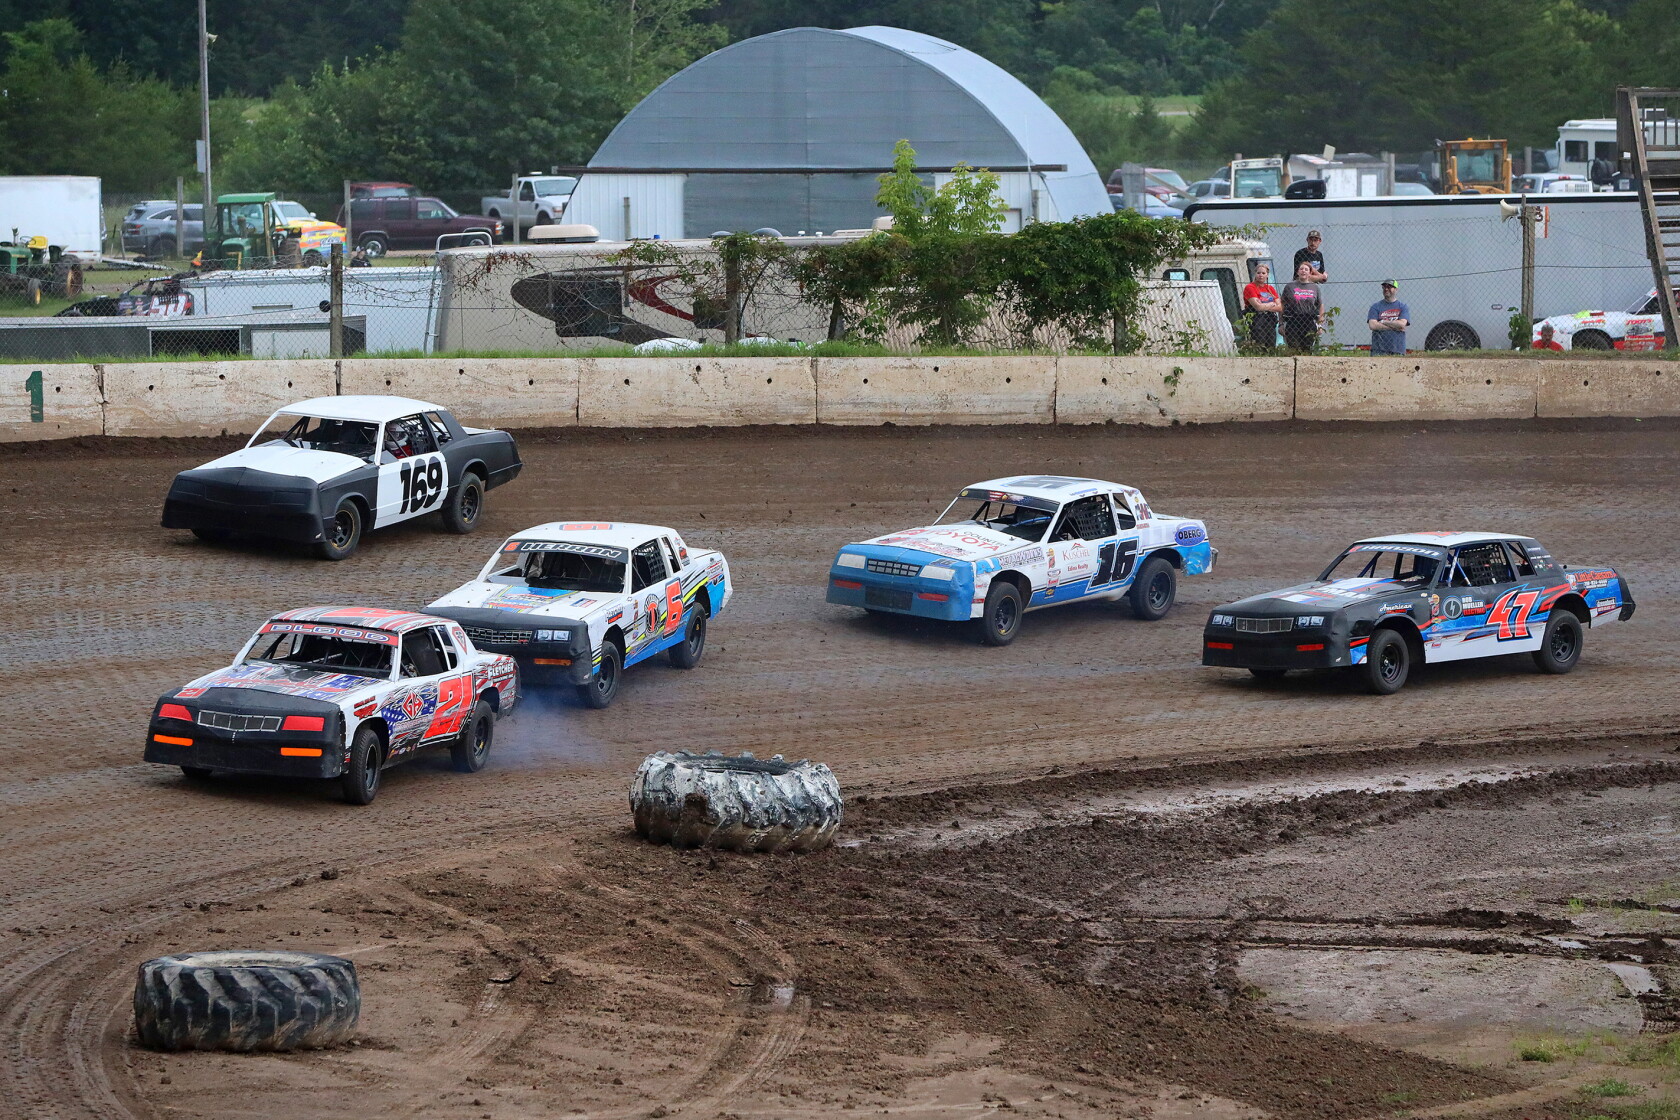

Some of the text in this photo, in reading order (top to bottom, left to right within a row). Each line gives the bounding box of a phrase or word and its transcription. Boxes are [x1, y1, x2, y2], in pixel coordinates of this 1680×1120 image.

[26, 371, 43, 423] 1
[399, 457, 443, 514] 169
[504, 541, 522, 551] 6
[520, 542, 622, 559] HERRON
[926, 529, 1000, 552] TOYOTA
[1177, 528, 1202, 541] OBERG
[1090, 539, 1139, 587] 16
[663, 577, 684, 640] 6
[1379, 603, 1413, 612] American
[1486, 590, 1541, 641] 47
[269, 623, 390, 642] BLOOD
[487, 661, 515, 681] FLETCHER
[419, 671, 475, 743] 21
